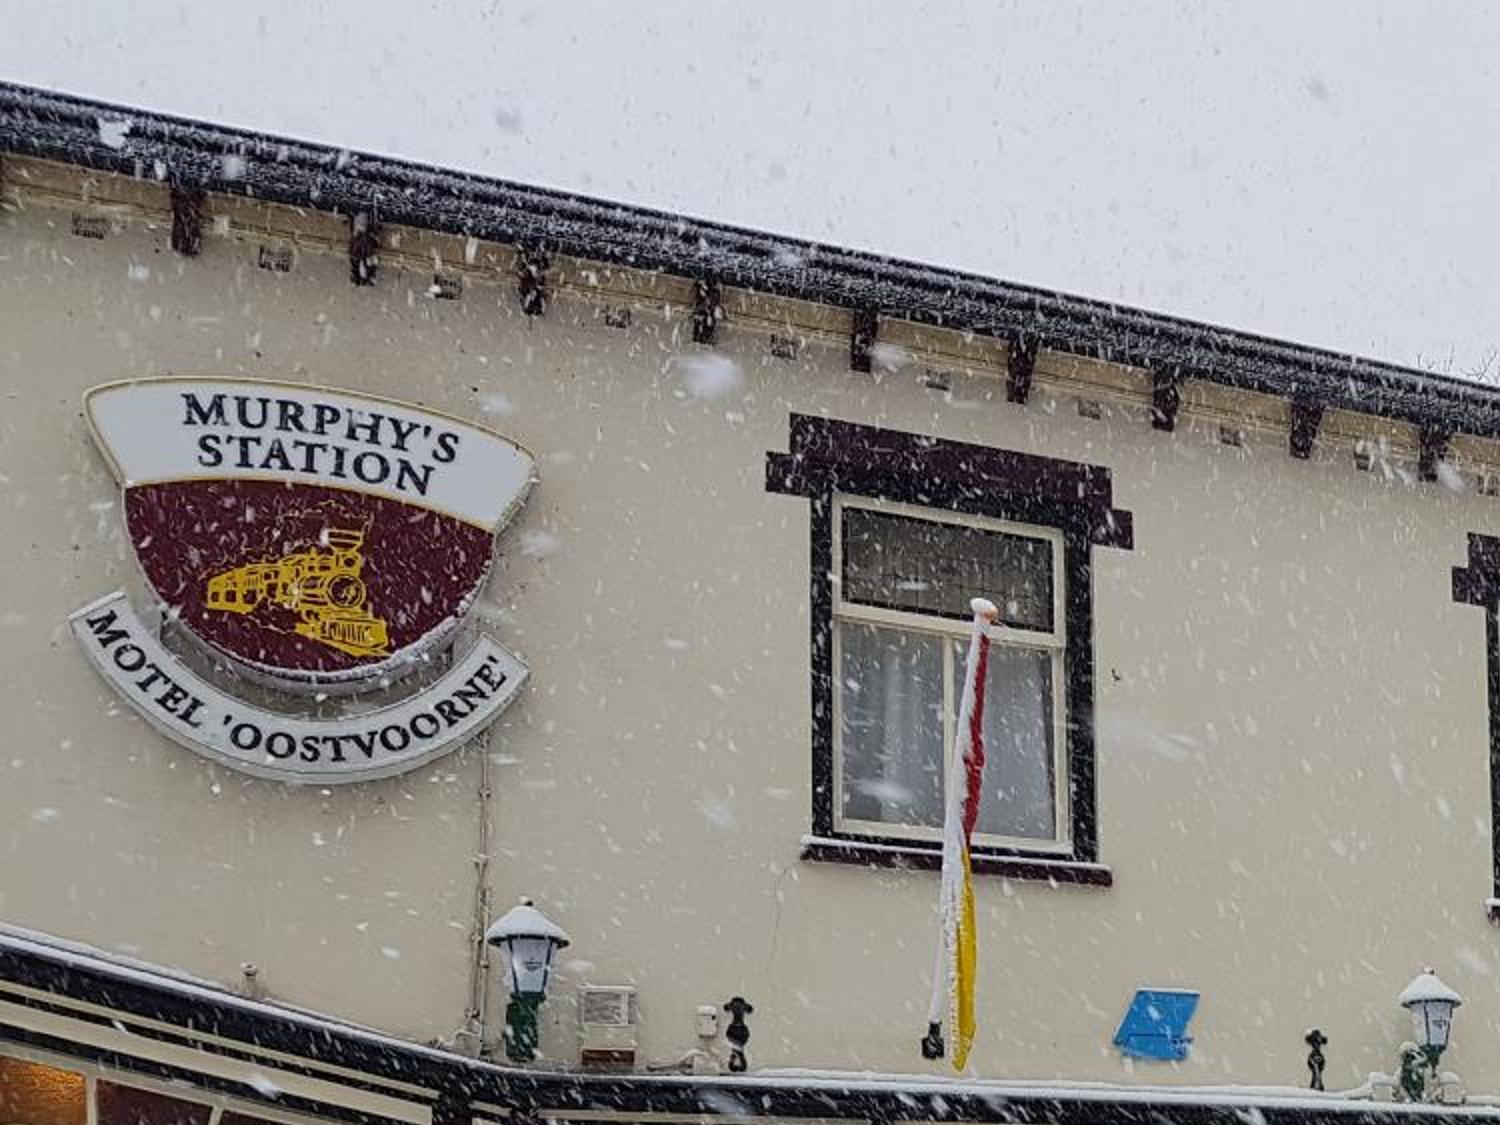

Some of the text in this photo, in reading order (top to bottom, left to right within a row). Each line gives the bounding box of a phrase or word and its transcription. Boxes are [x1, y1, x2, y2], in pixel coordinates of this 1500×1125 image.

[182, 392, 461, 464] MURPHY'S
[197, 434, 436, 496] STATION
[86, 610, 507, 763] MOTEL 'OOSTVOORNE'
